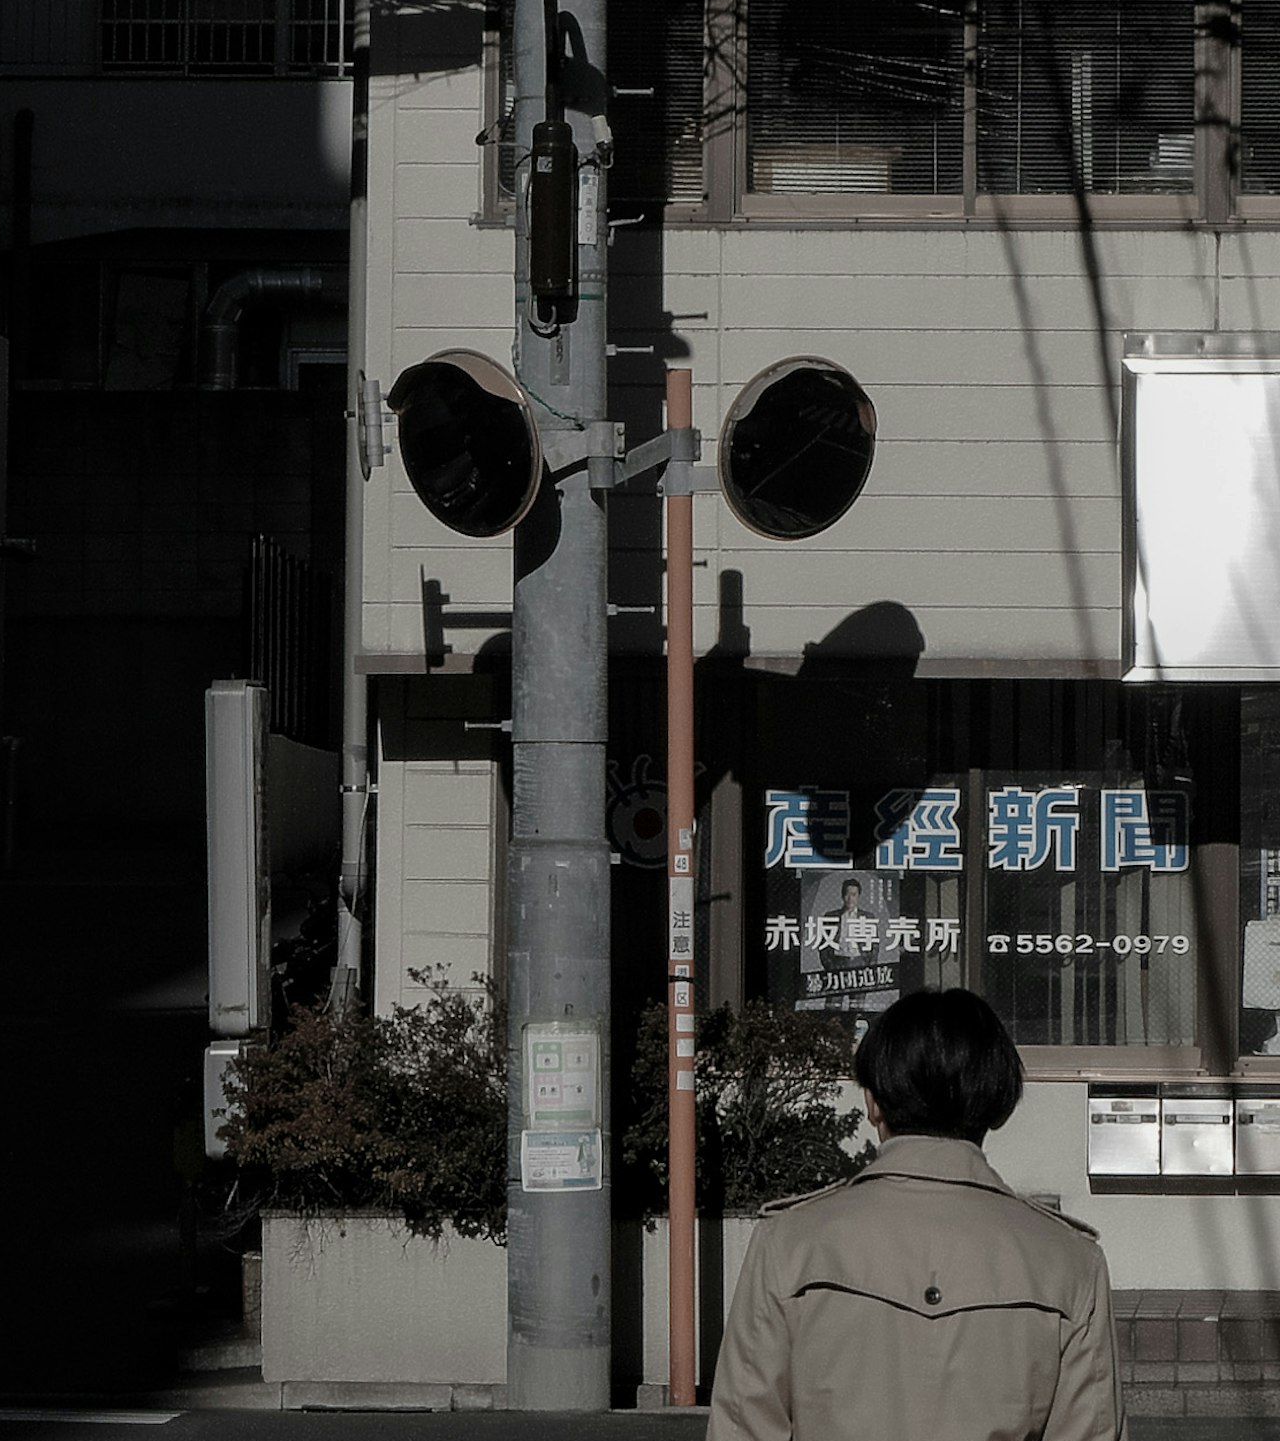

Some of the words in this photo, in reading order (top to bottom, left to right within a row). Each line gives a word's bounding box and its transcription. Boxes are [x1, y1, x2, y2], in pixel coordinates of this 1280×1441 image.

[673, 910, 691, 953] 注意
[763, 913, 961, 954] 赤坂専売所
[1016, 933, 1191, 954] 5562-0979
[805, 966, 895, 993] 暴力団追放
